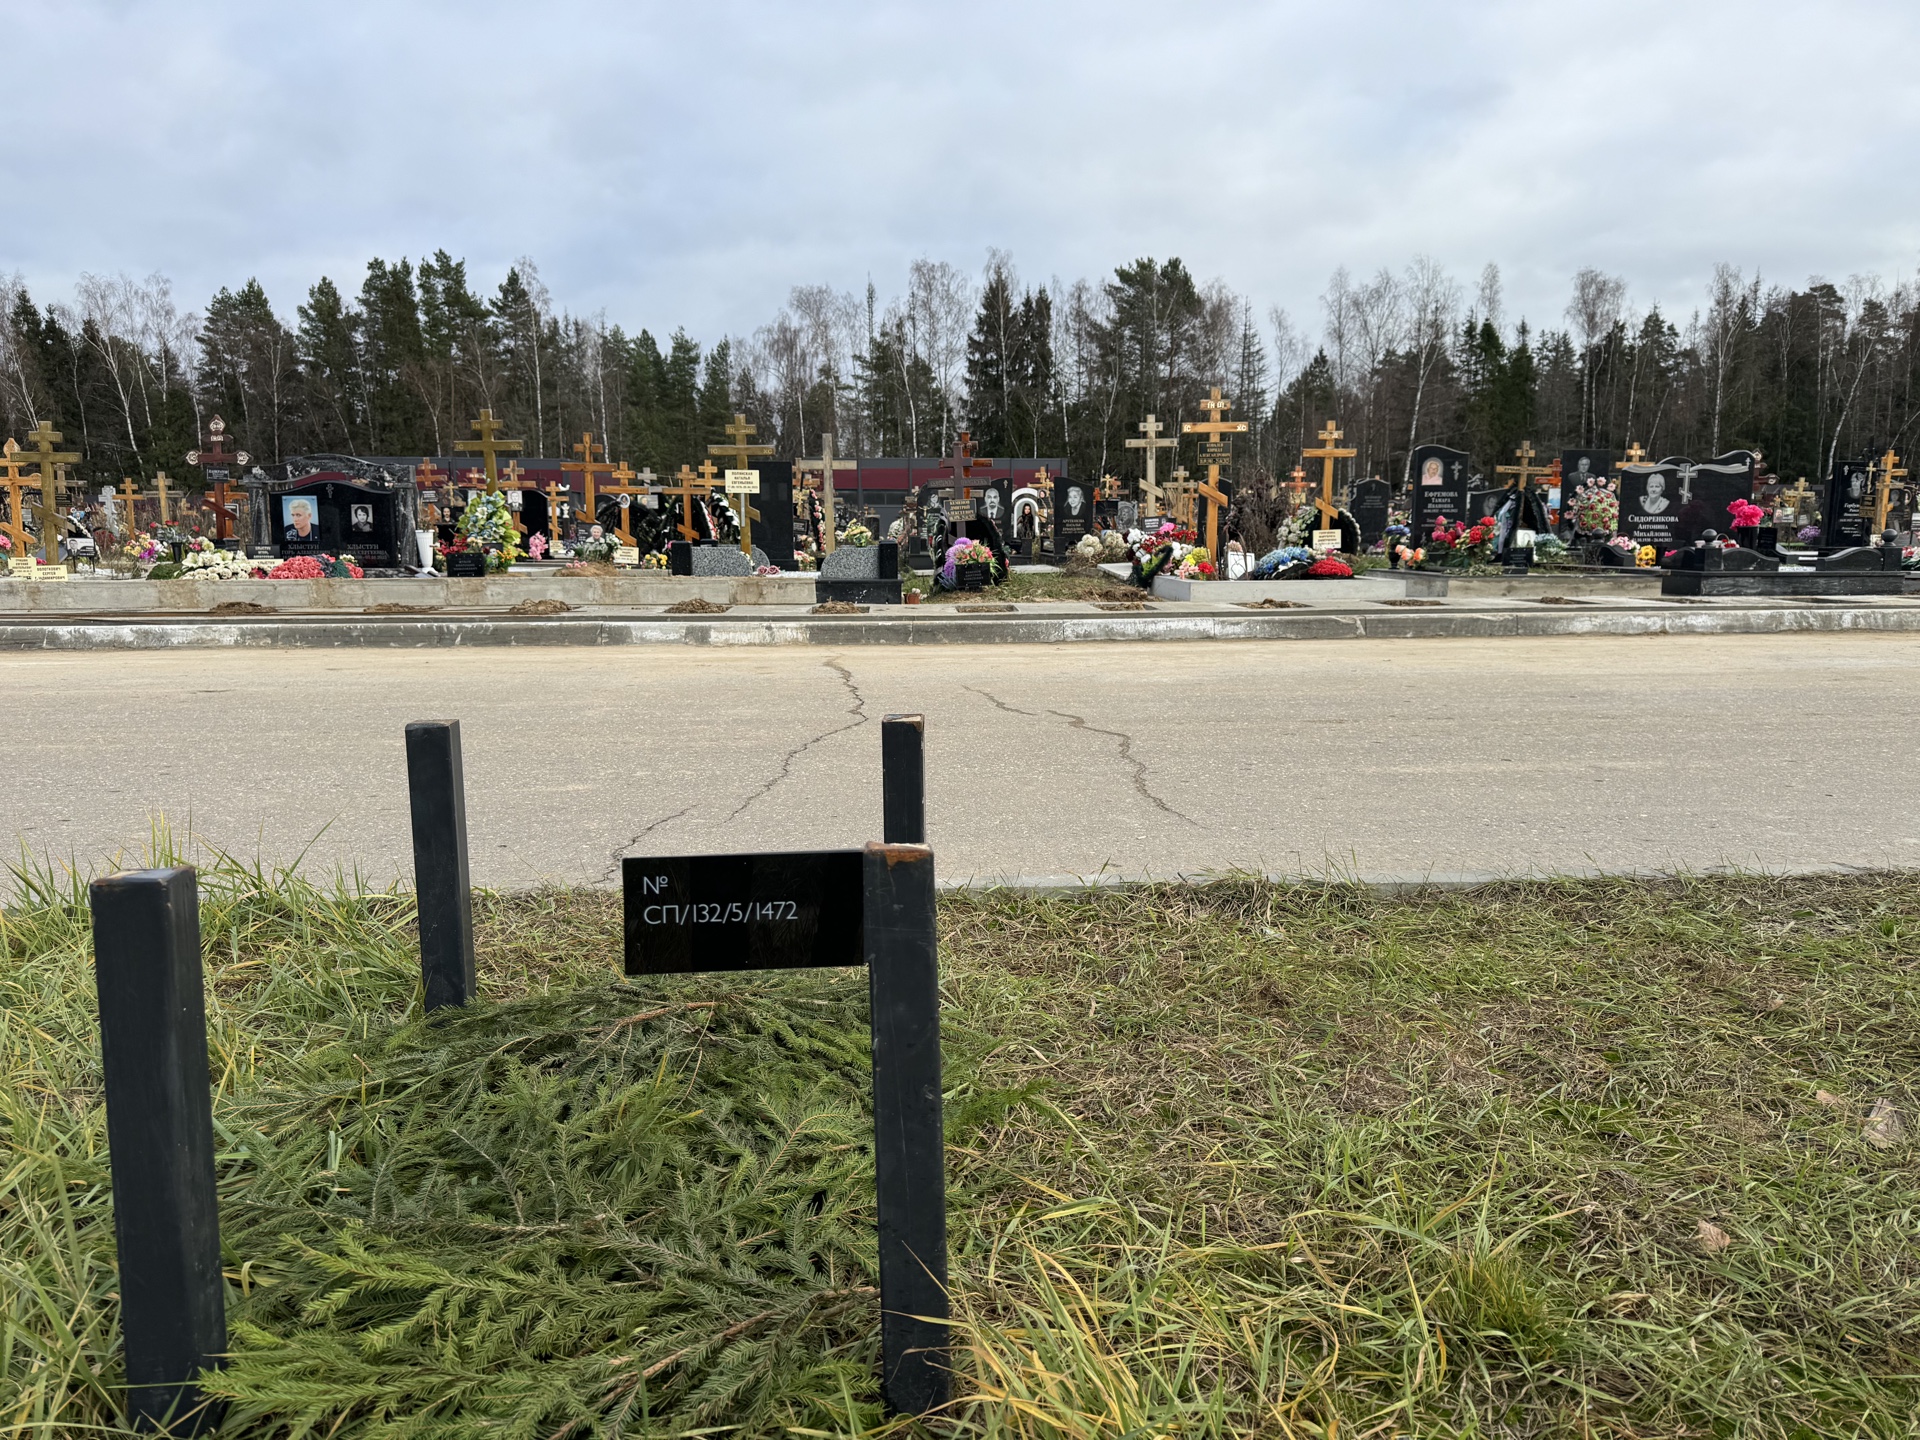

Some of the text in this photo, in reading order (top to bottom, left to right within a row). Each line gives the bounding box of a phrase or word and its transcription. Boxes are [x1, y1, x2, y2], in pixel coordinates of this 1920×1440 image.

[1424, 490, 1458, 498] ЕФРЕМОВА
[1628, 514, 1679, 523] СИДОРЕНКОВА
[643, 875, 669, 895] №
[643, 900, 799, 926] СП/132/5/1472
